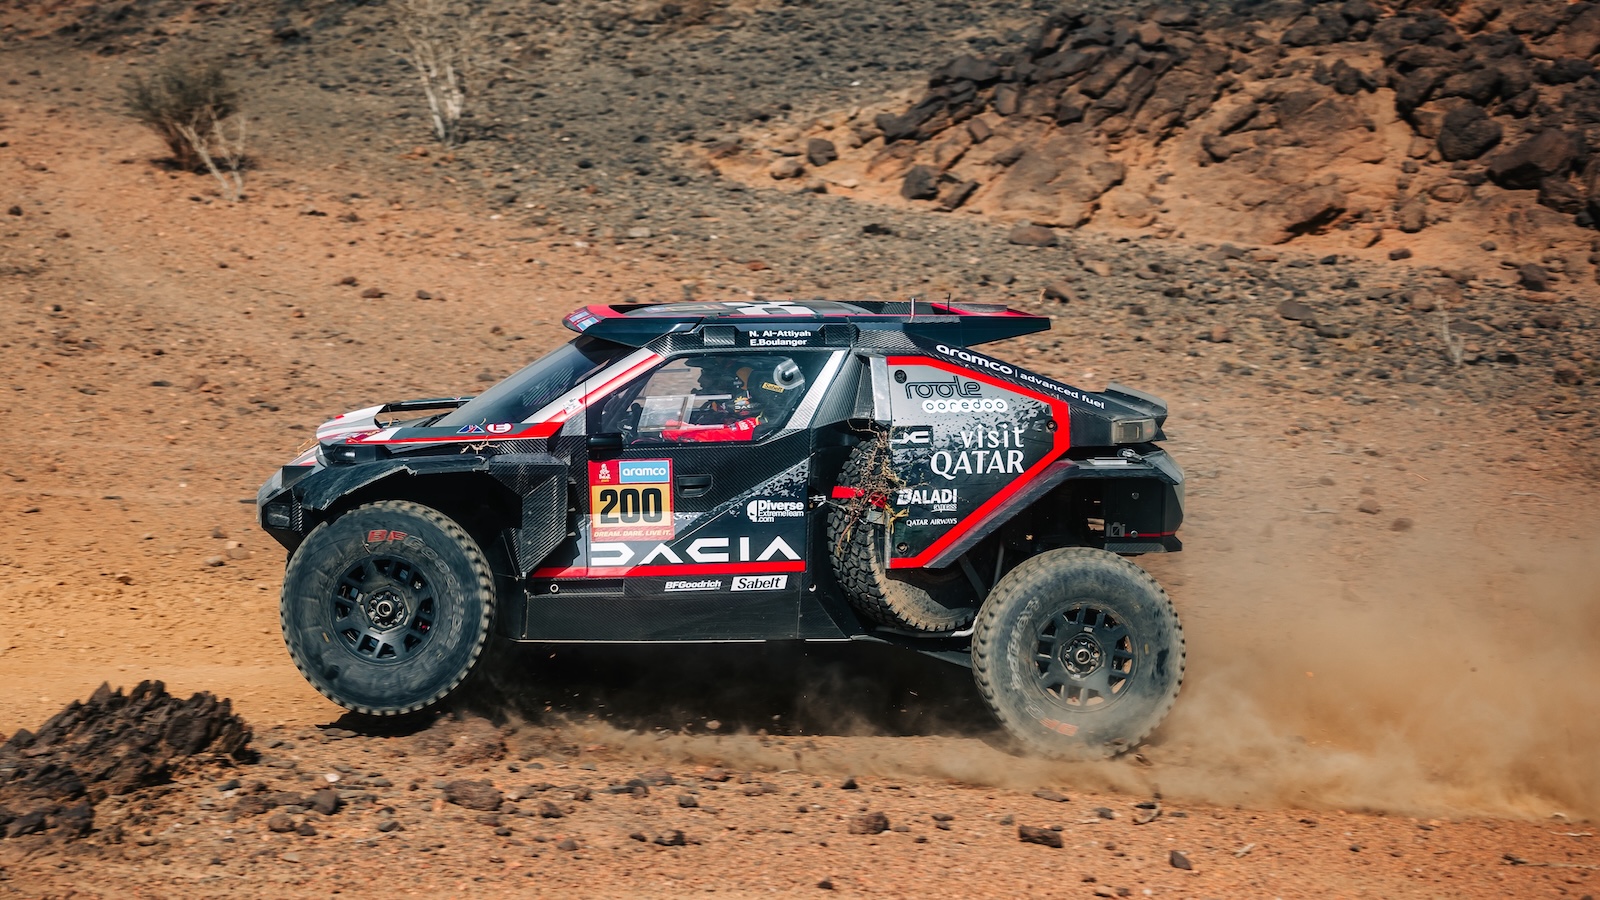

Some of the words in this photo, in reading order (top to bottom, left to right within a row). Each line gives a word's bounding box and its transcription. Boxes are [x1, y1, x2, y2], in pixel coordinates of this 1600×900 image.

[763, 330, 811, 338] Al-Attiyah
[935, 344, 1013, 375] aramco
[1020, 369, 1078, 400] advanced
[1082, 394, 1105, 410] fuel
[923, 398, 1008, 413] ooredoo
[960, 423, 1024, 448] visit
[622, 467, 666, 476] aramco
[930, 450, 1025, 480] QATAR
[897, 489, 957, 505] BALADI
[600, 488, 662, 524] 200
[758, 500, 804, 510] Diverse
[906, 519, 929, 527] QATAR
[591, 535, 801, 566] DACIA
[664, 580, 722, 589] BFGoodrich
[737, 577, 781, 589] Sabelt
